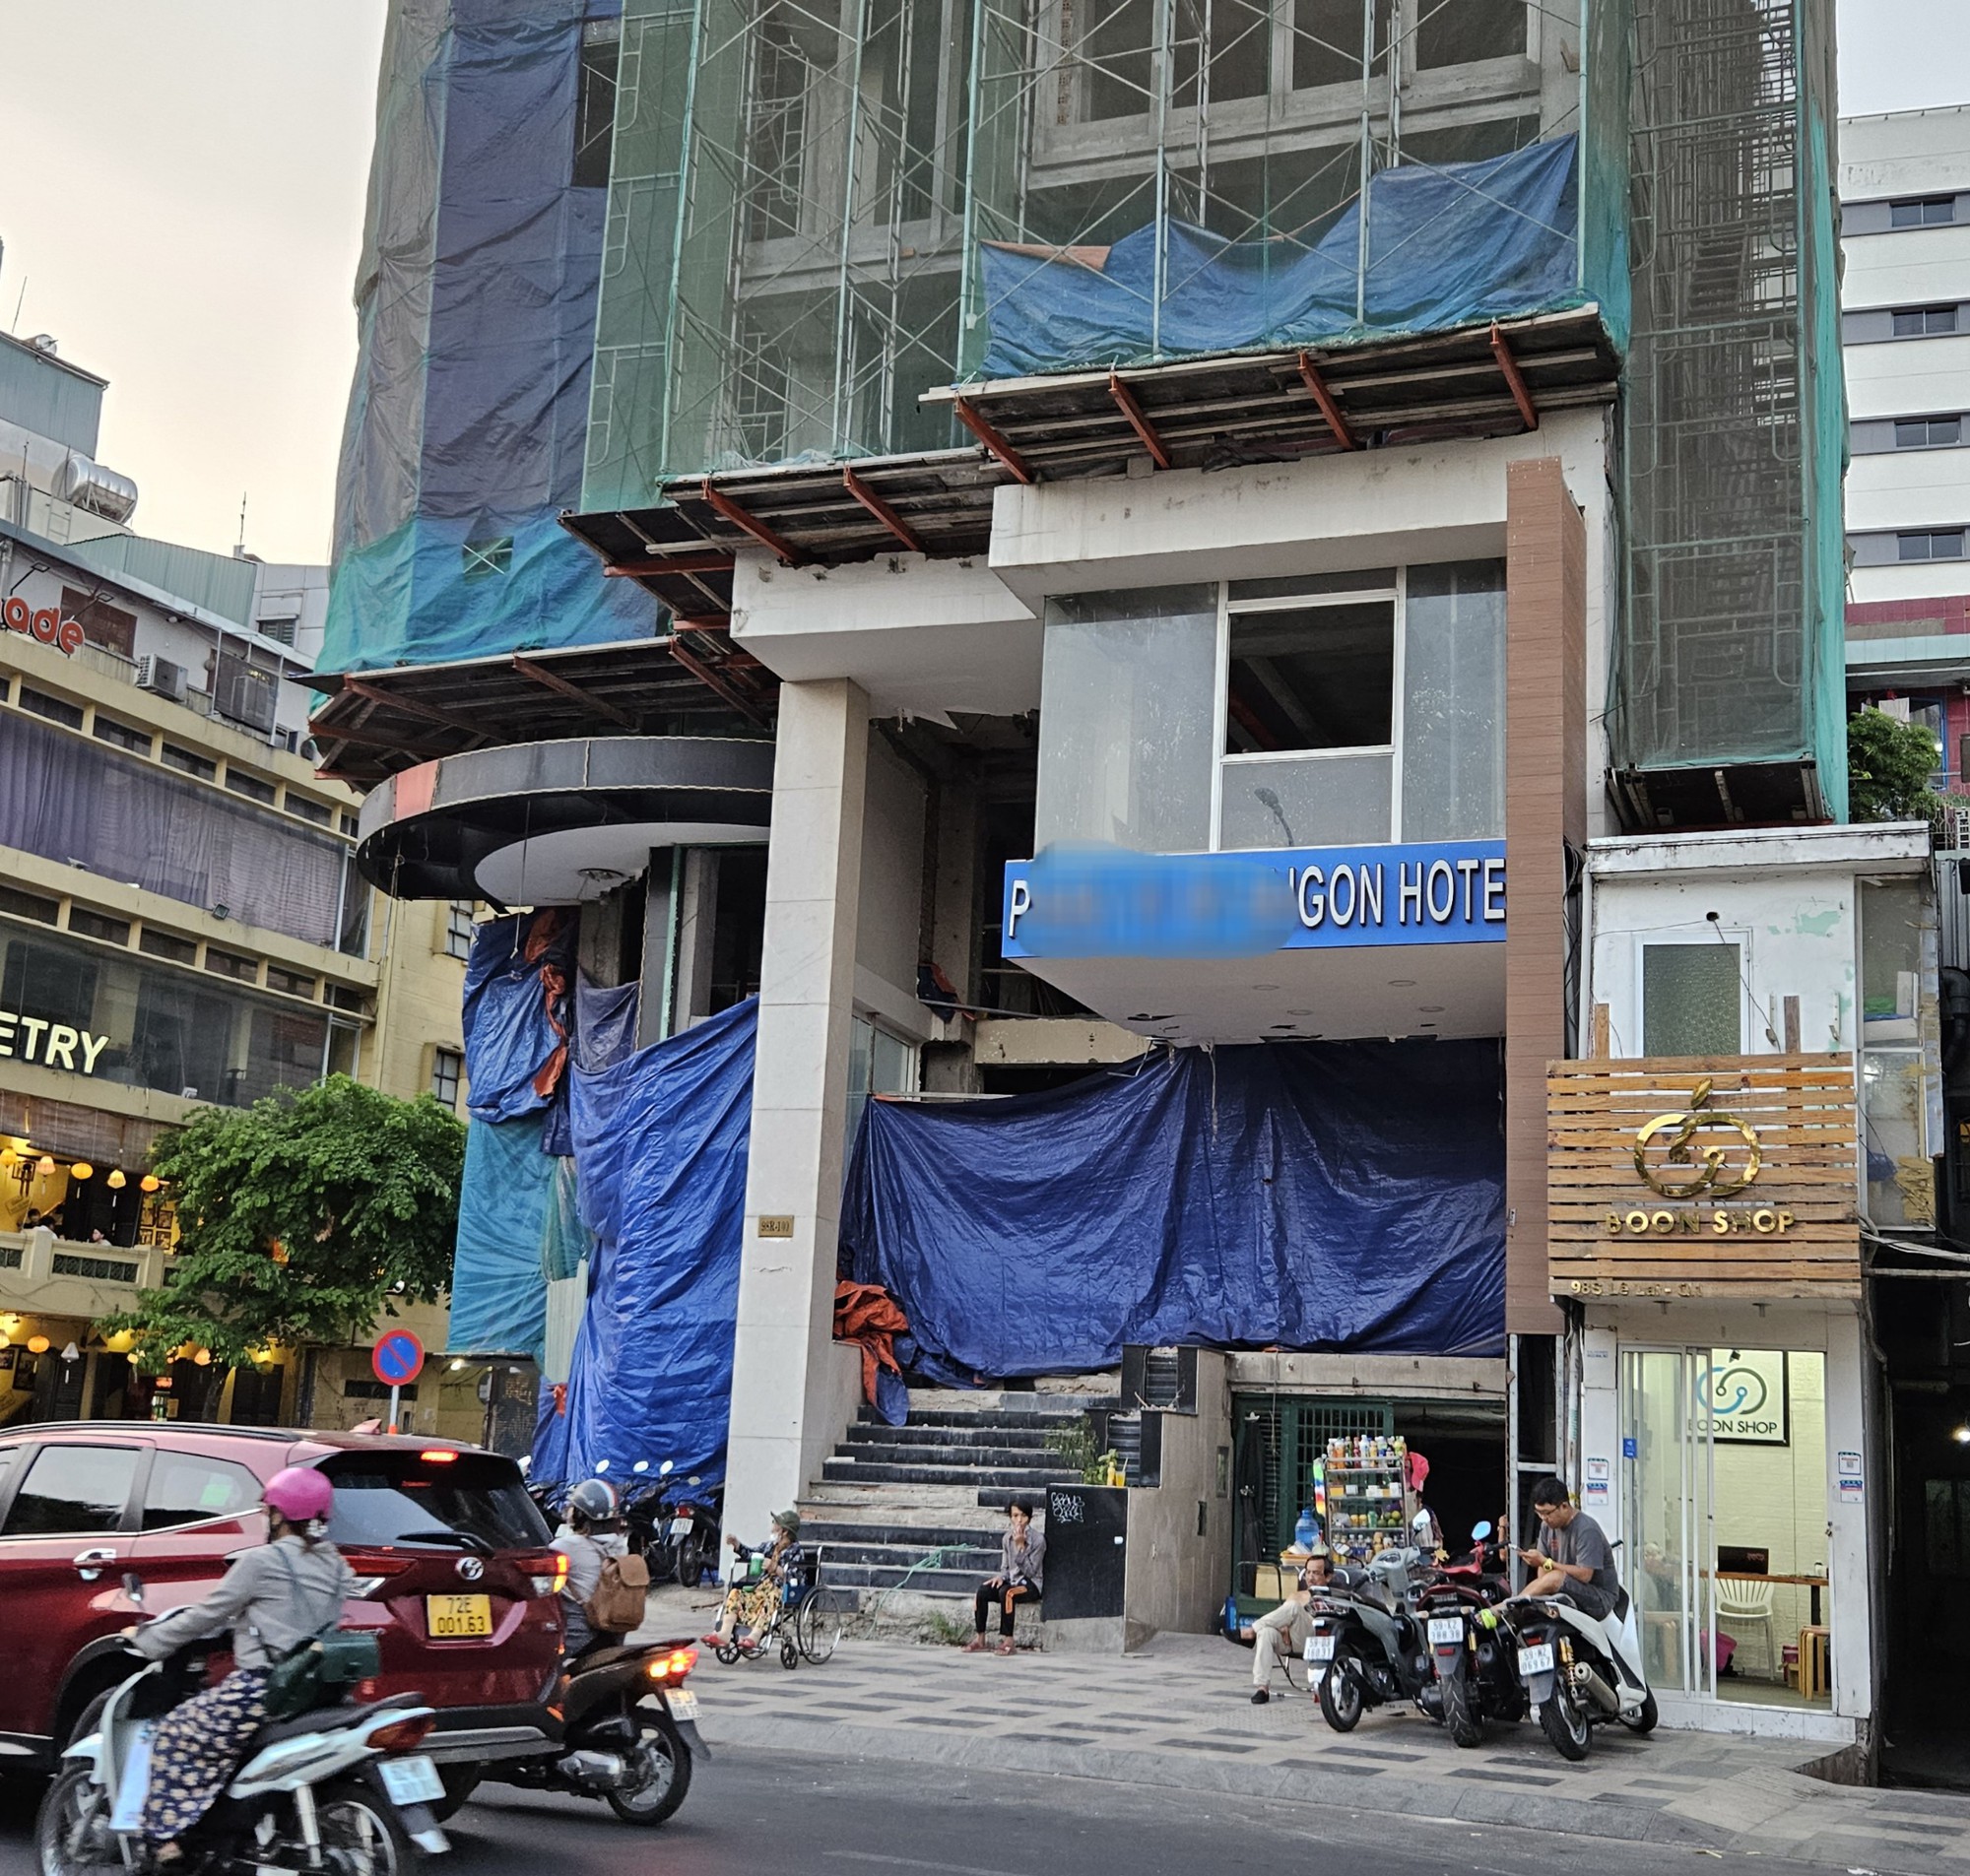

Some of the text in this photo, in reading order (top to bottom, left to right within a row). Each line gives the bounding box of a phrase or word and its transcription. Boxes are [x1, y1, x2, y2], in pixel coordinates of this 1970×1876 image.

[0, 597, 85, 655] ade
[1400, 858, 1505, 923] HOTE
[1605, 1208, 1795, 1234] BOON SHOP
[1570, 1280, 1603, 1296] 98S
[1737, 1420, 1778, 1434] SHOP
[447, 1596, 473, 1614] 72E
[437, 1616, 485, 1634] 001.63
